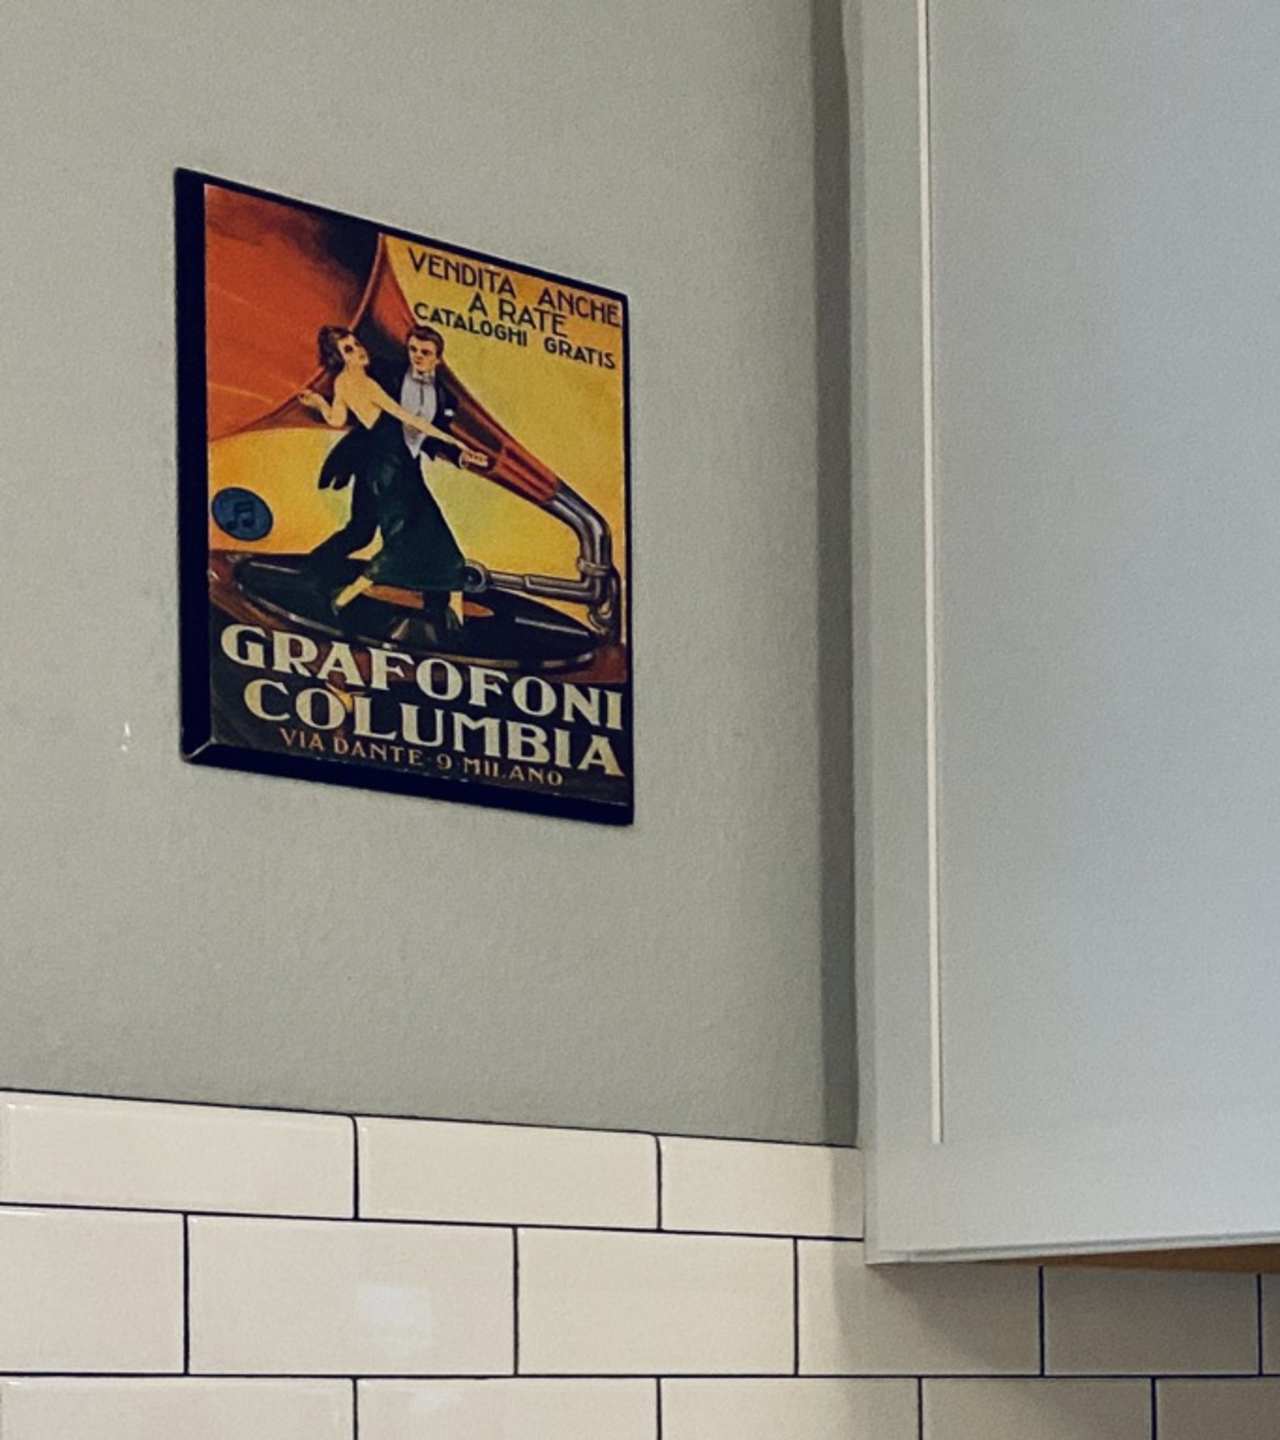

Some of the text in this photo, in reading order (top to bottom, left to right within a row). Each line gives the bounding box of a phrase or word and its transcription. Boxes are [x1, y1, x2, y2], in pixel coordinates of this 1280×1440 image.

[408, 247, 621, 328] VENDITA ANCHE
[468, 292, 568, 339] A RATE
[414, 302, 616, 370] CATALOGHI GRATIS
[221, 623, 623, 730] GRAFOFONI
[244, 679, 625, 777] COLUMBIA
[279, 728, 564, 787] VIA DANTE 9 MILANO
